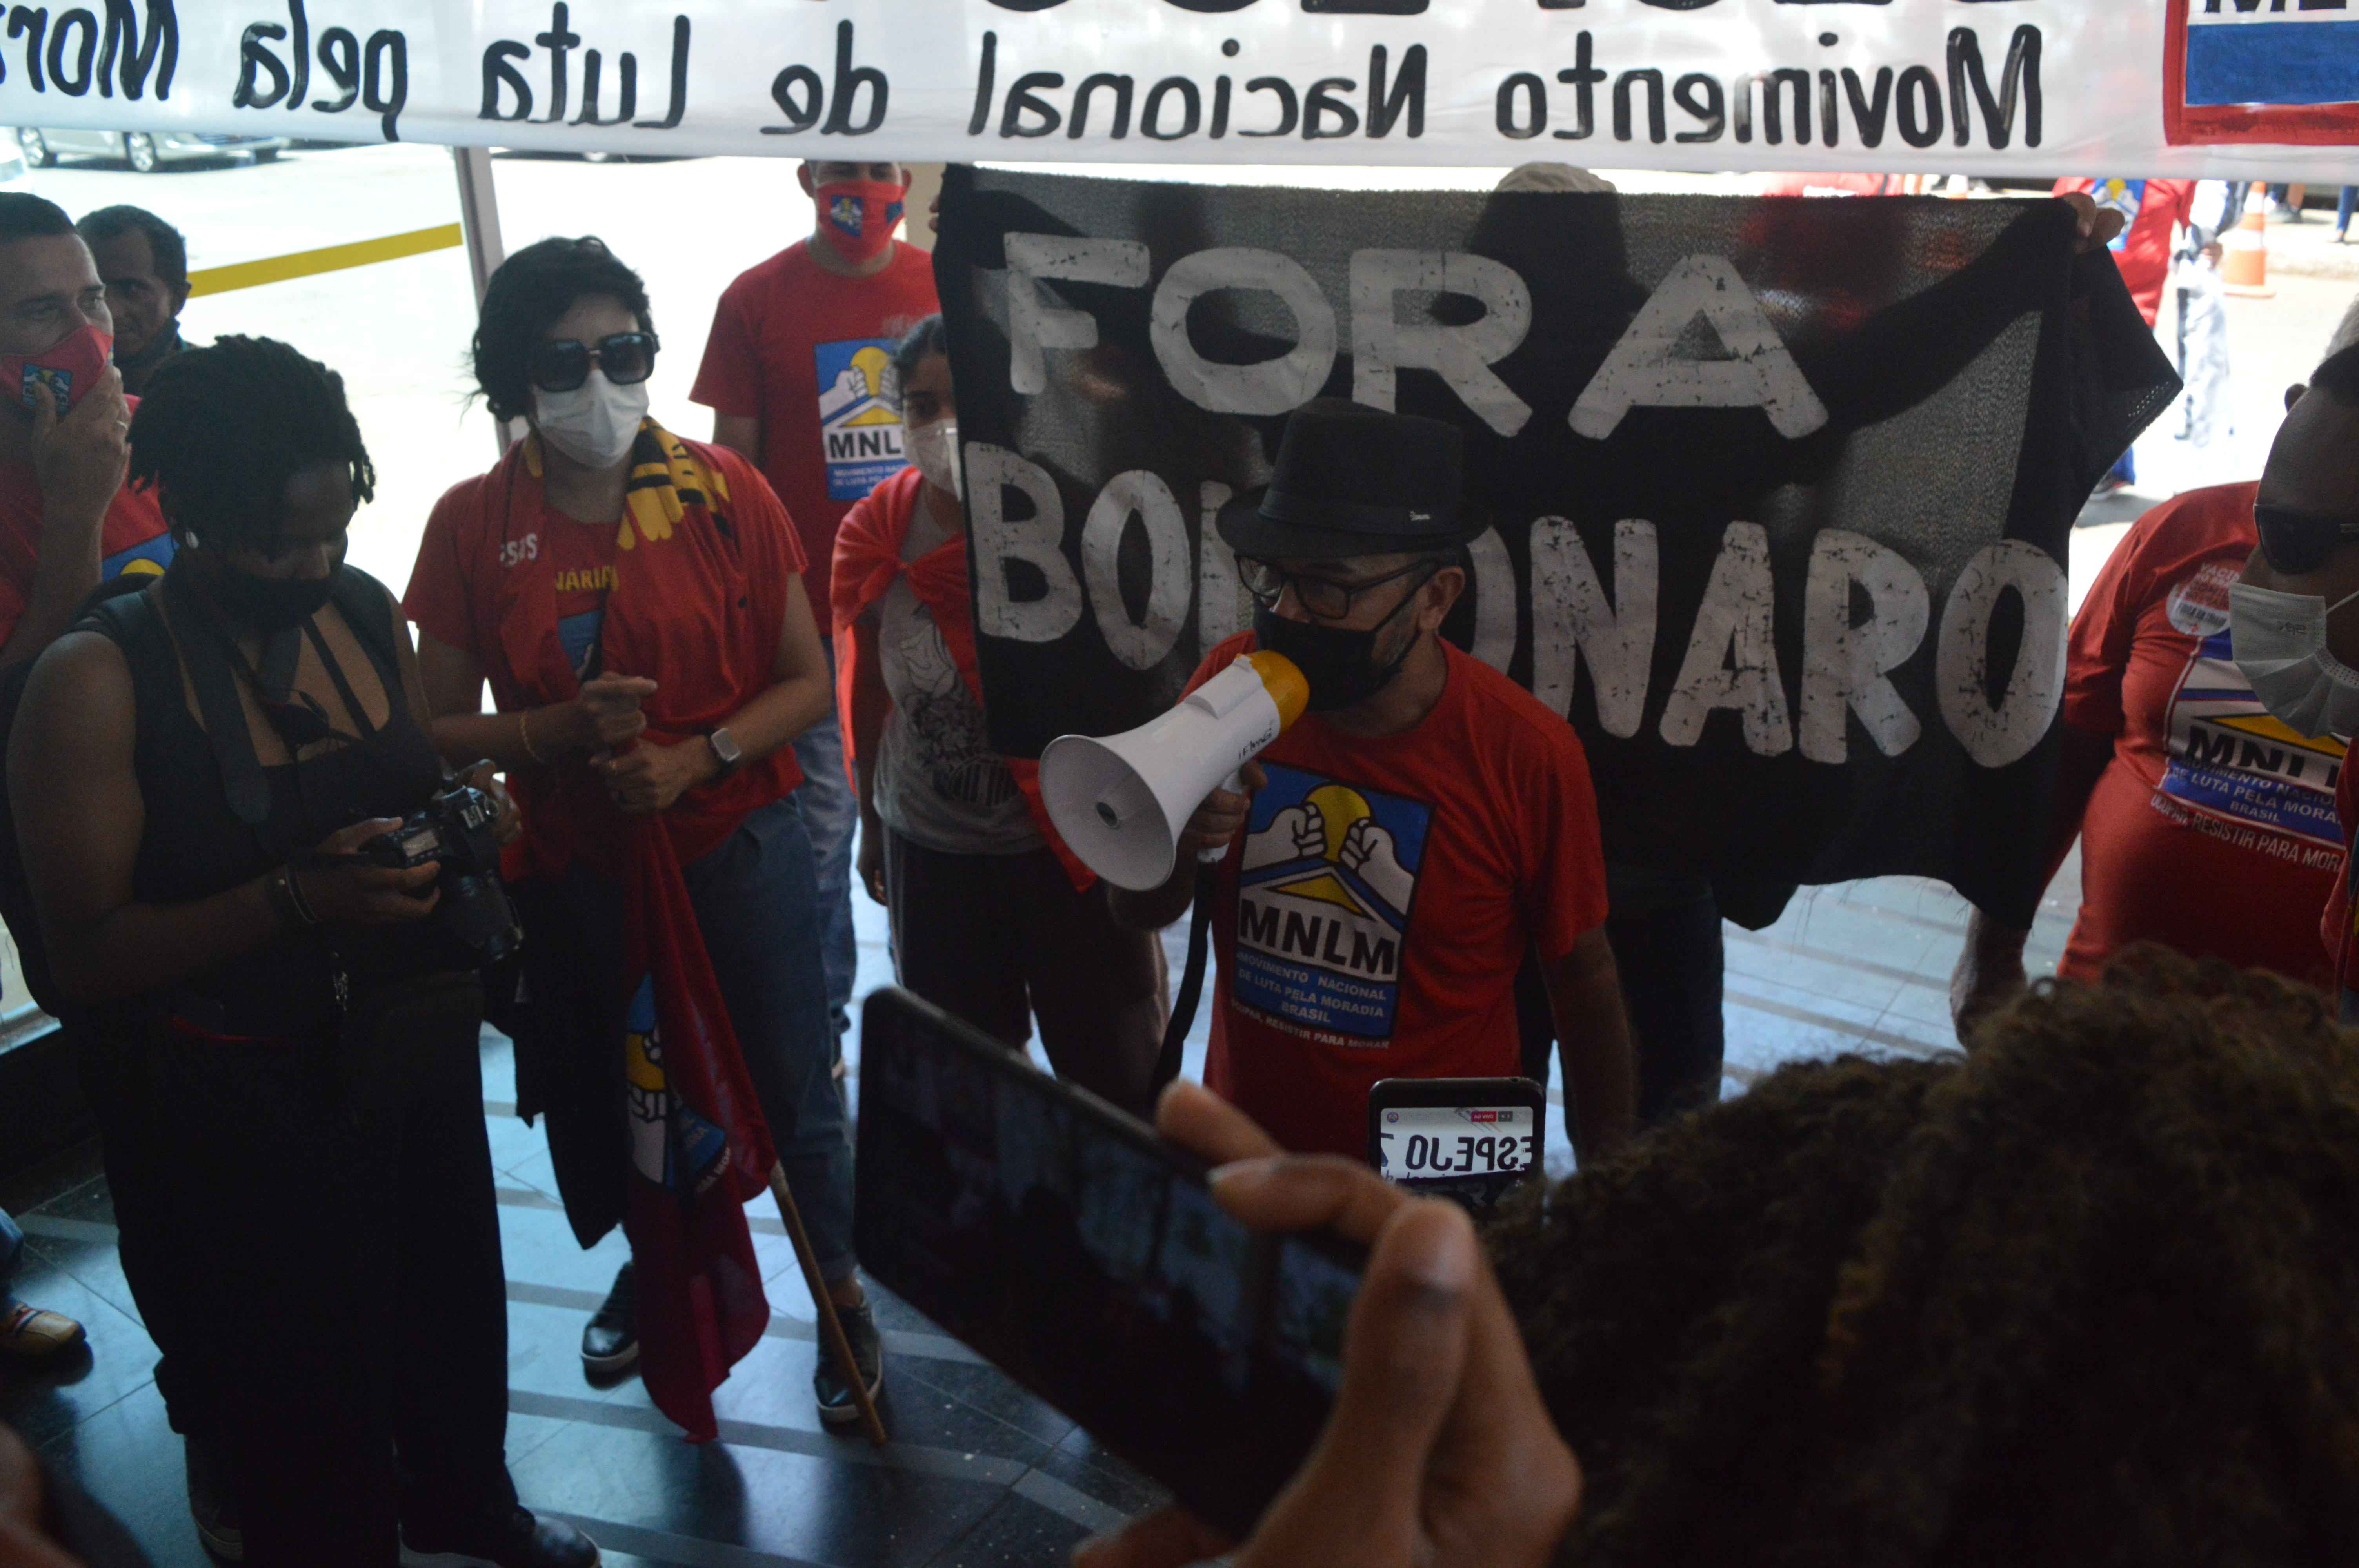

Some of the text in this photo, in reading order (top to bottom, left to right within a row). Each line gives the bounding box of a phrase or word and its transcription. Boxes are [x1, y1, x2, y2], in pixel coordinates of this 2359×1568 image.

[1003, 231, 1829, 440] FORA
[828, 429, 901, 459] MNL
[2191, 772, 2230, 794] LUTA
[2233, 786, 2278, 809] PELA
[2283, 801, 2341, 825] MORA
[2229, 800, 2280, 823] BRASIL
[2191, 812, 2257, 849] RESISTIR
[2256, 835, 2300, 863] PARA
[1239, 898, 1396, 975] MNLM
[1236, 951, 1386, 1000] MOVIMENTO NACIONAL
[1238, 968, 1384, 1017] DE LUTA PELA MORADIA
[1281, 1002, 1332, 1024] BRASIL
[1313, 1032, 1345, 1046] PARA
